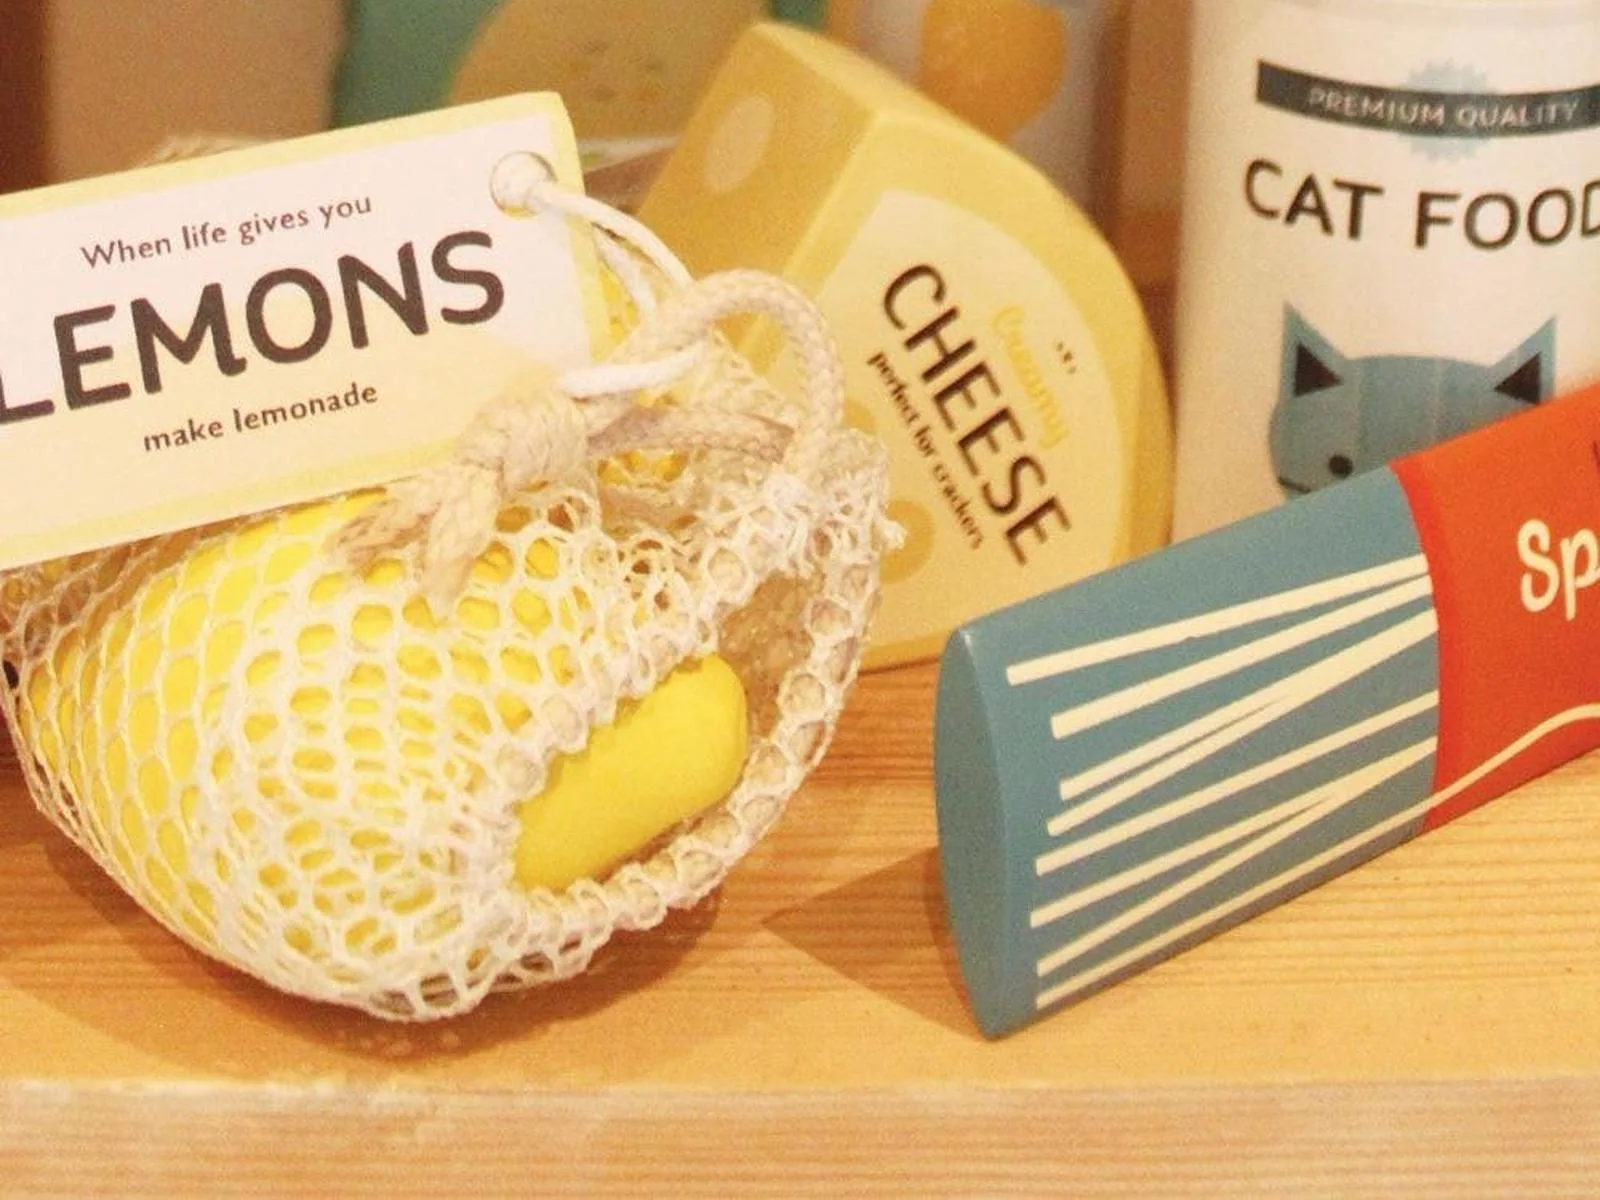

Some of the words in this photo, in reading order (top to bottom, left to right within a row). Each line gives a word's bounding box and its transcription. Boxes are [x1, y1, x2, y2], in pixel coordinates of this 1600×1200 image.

[1307, 87, 1445, 126] PREMIUM
[1456, 99, 1581, 128] QUALITY
[80, 238, 171, 269] When
[181, 221, 227, 250] life
[238, 208, 309, 246] gives
[318, 196, 372, 229] you
[1244, 157, 1384, 240] CAT
[143, 417, 224, 453] make
[232, 381, 379, 433] lemonade
[866, 351, 921, 426] perfect
[914, 423, 938, 459] for
[932, 463, 985, 551] crackers
[883, 263, 1073, 567] CHEESE
